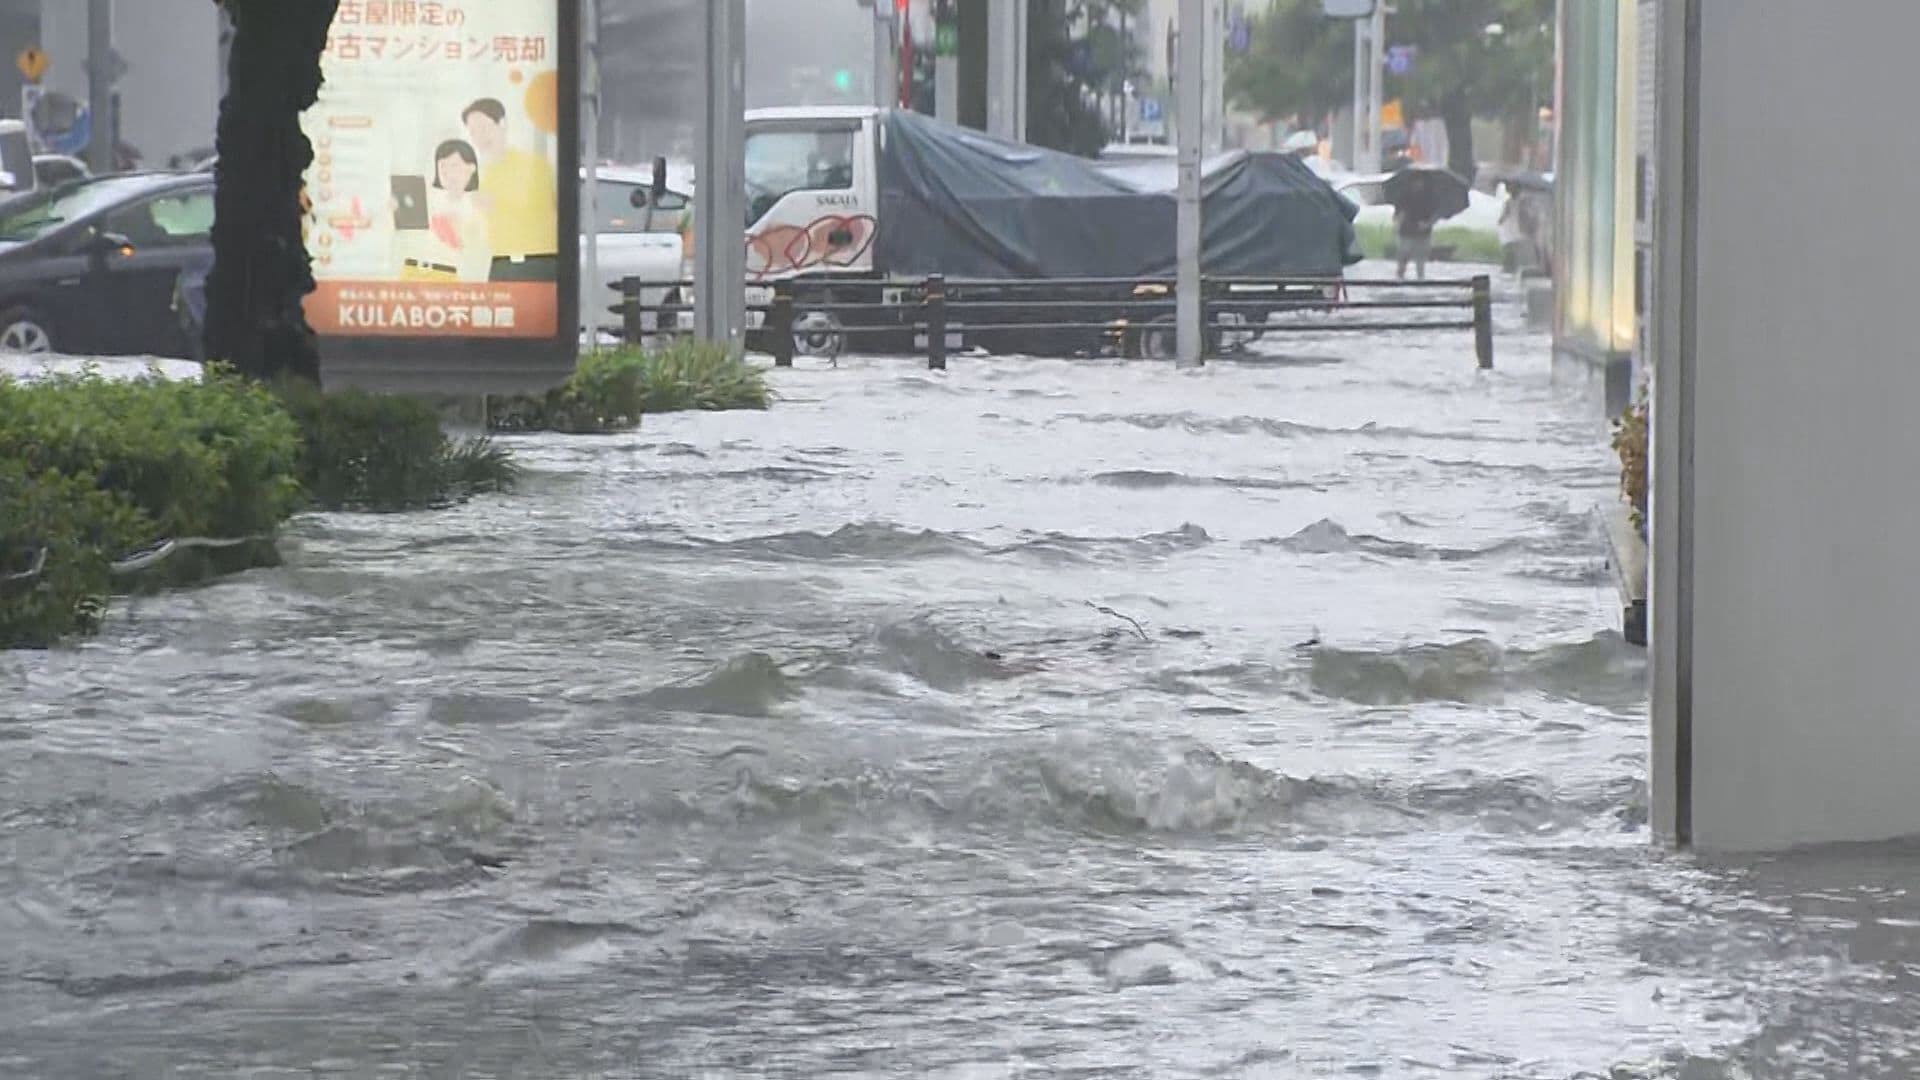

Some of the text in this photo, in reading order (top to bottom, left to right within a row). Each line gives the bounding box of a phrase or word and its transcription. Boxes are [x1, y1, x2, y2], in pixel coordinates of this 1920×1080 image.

[327, 33, 546, 62] 古マンション売却
